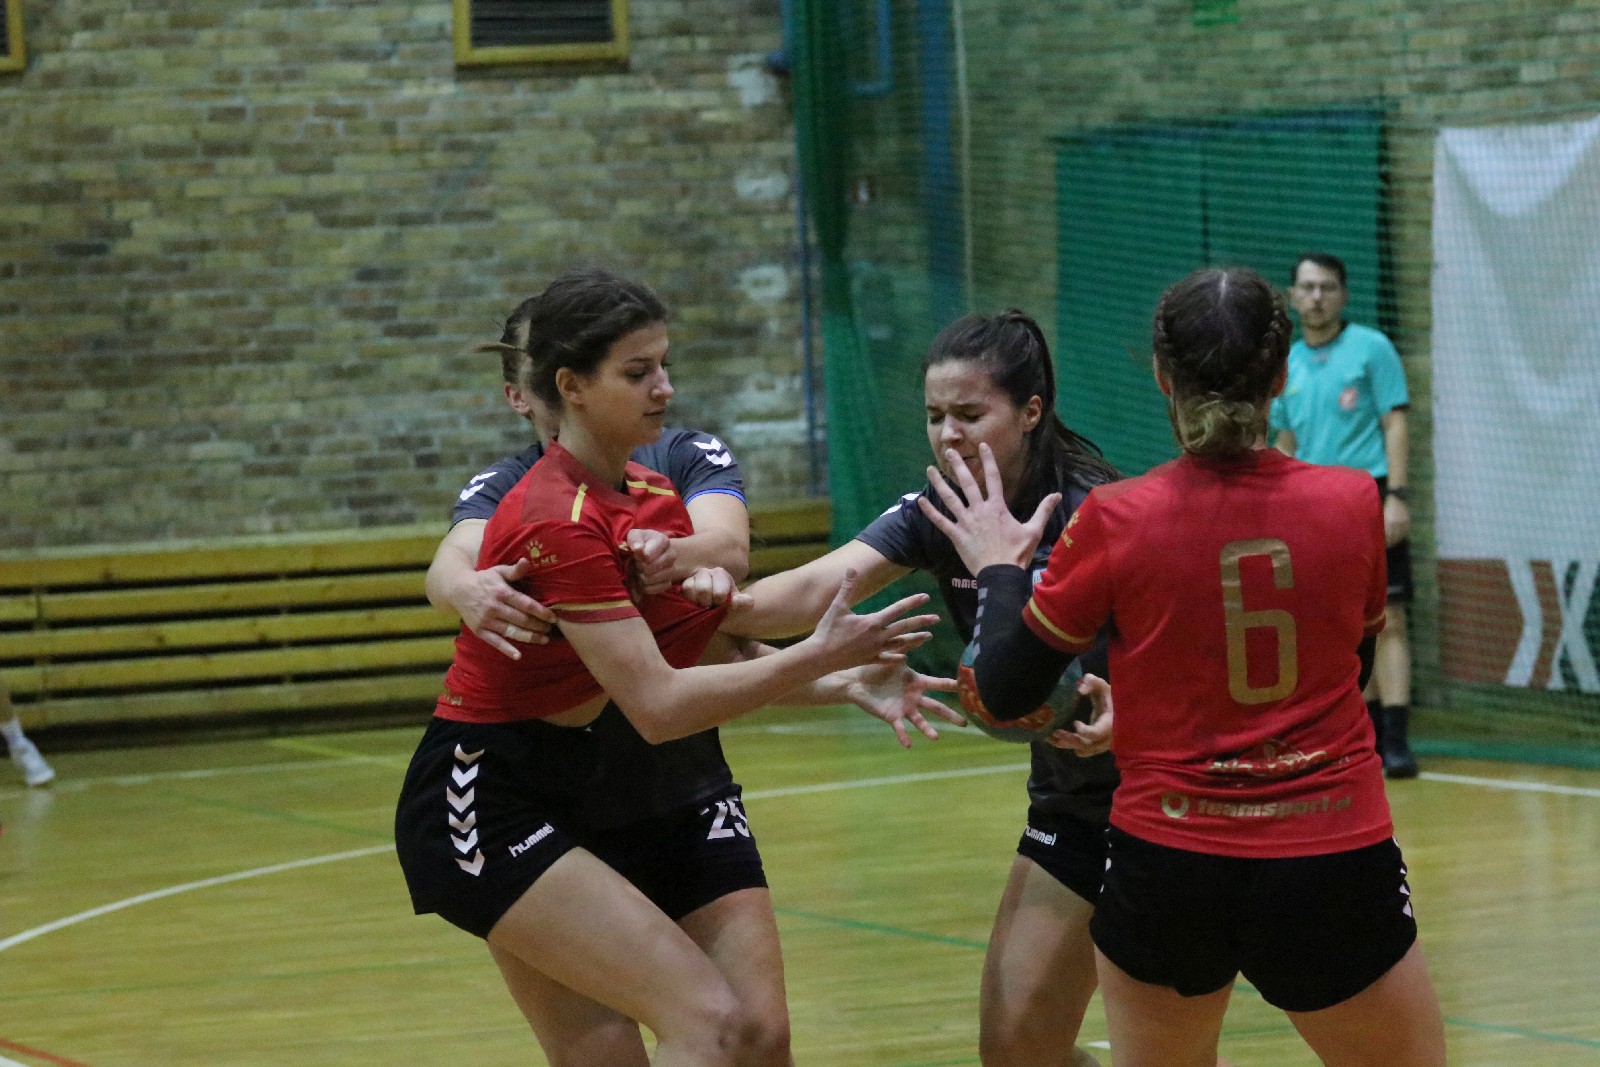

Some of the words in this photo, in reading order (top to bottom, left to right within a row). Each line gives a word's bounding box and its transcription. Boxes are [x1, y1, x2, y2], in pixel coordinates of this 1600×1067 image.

[1219, 538, 1298, 705] 6
[700, 795, 750, 839] 25
[1024, 824, 1057, 847] ummel
[508, 822, 555, 858] hummel
